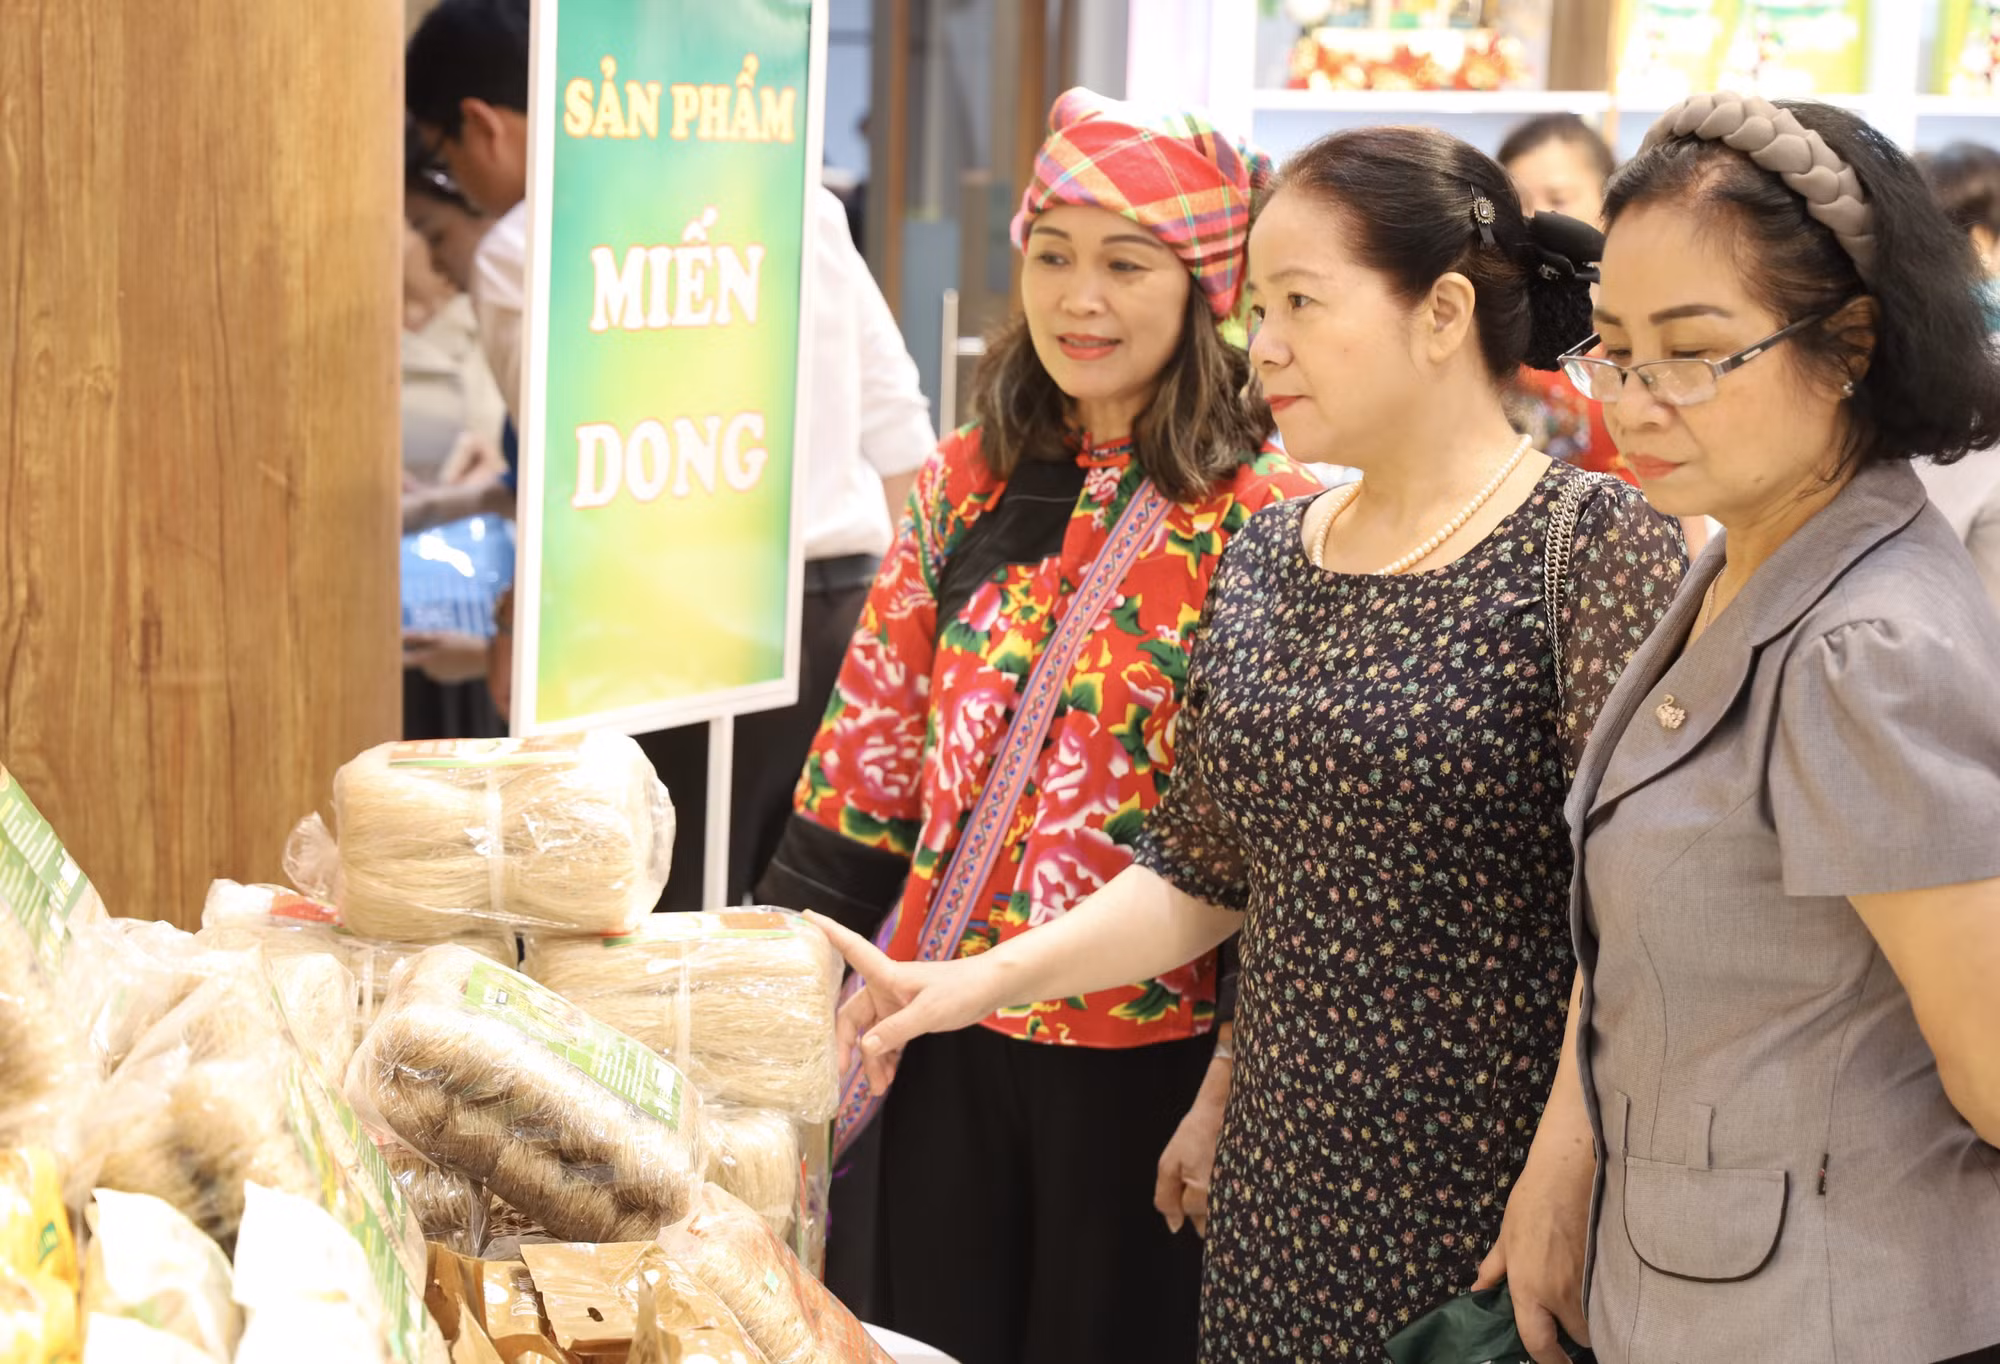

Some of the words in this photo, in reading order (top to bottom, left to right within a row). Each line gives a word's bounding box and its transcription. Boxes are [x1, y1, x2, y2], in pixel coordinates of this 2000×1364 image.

[563, 55, 661, 140] SẢN
[671, 53, 797, 142] PHẨM
[590, 206, 765, 332] MIẾN
[572, 412, 767, 508] DONG
